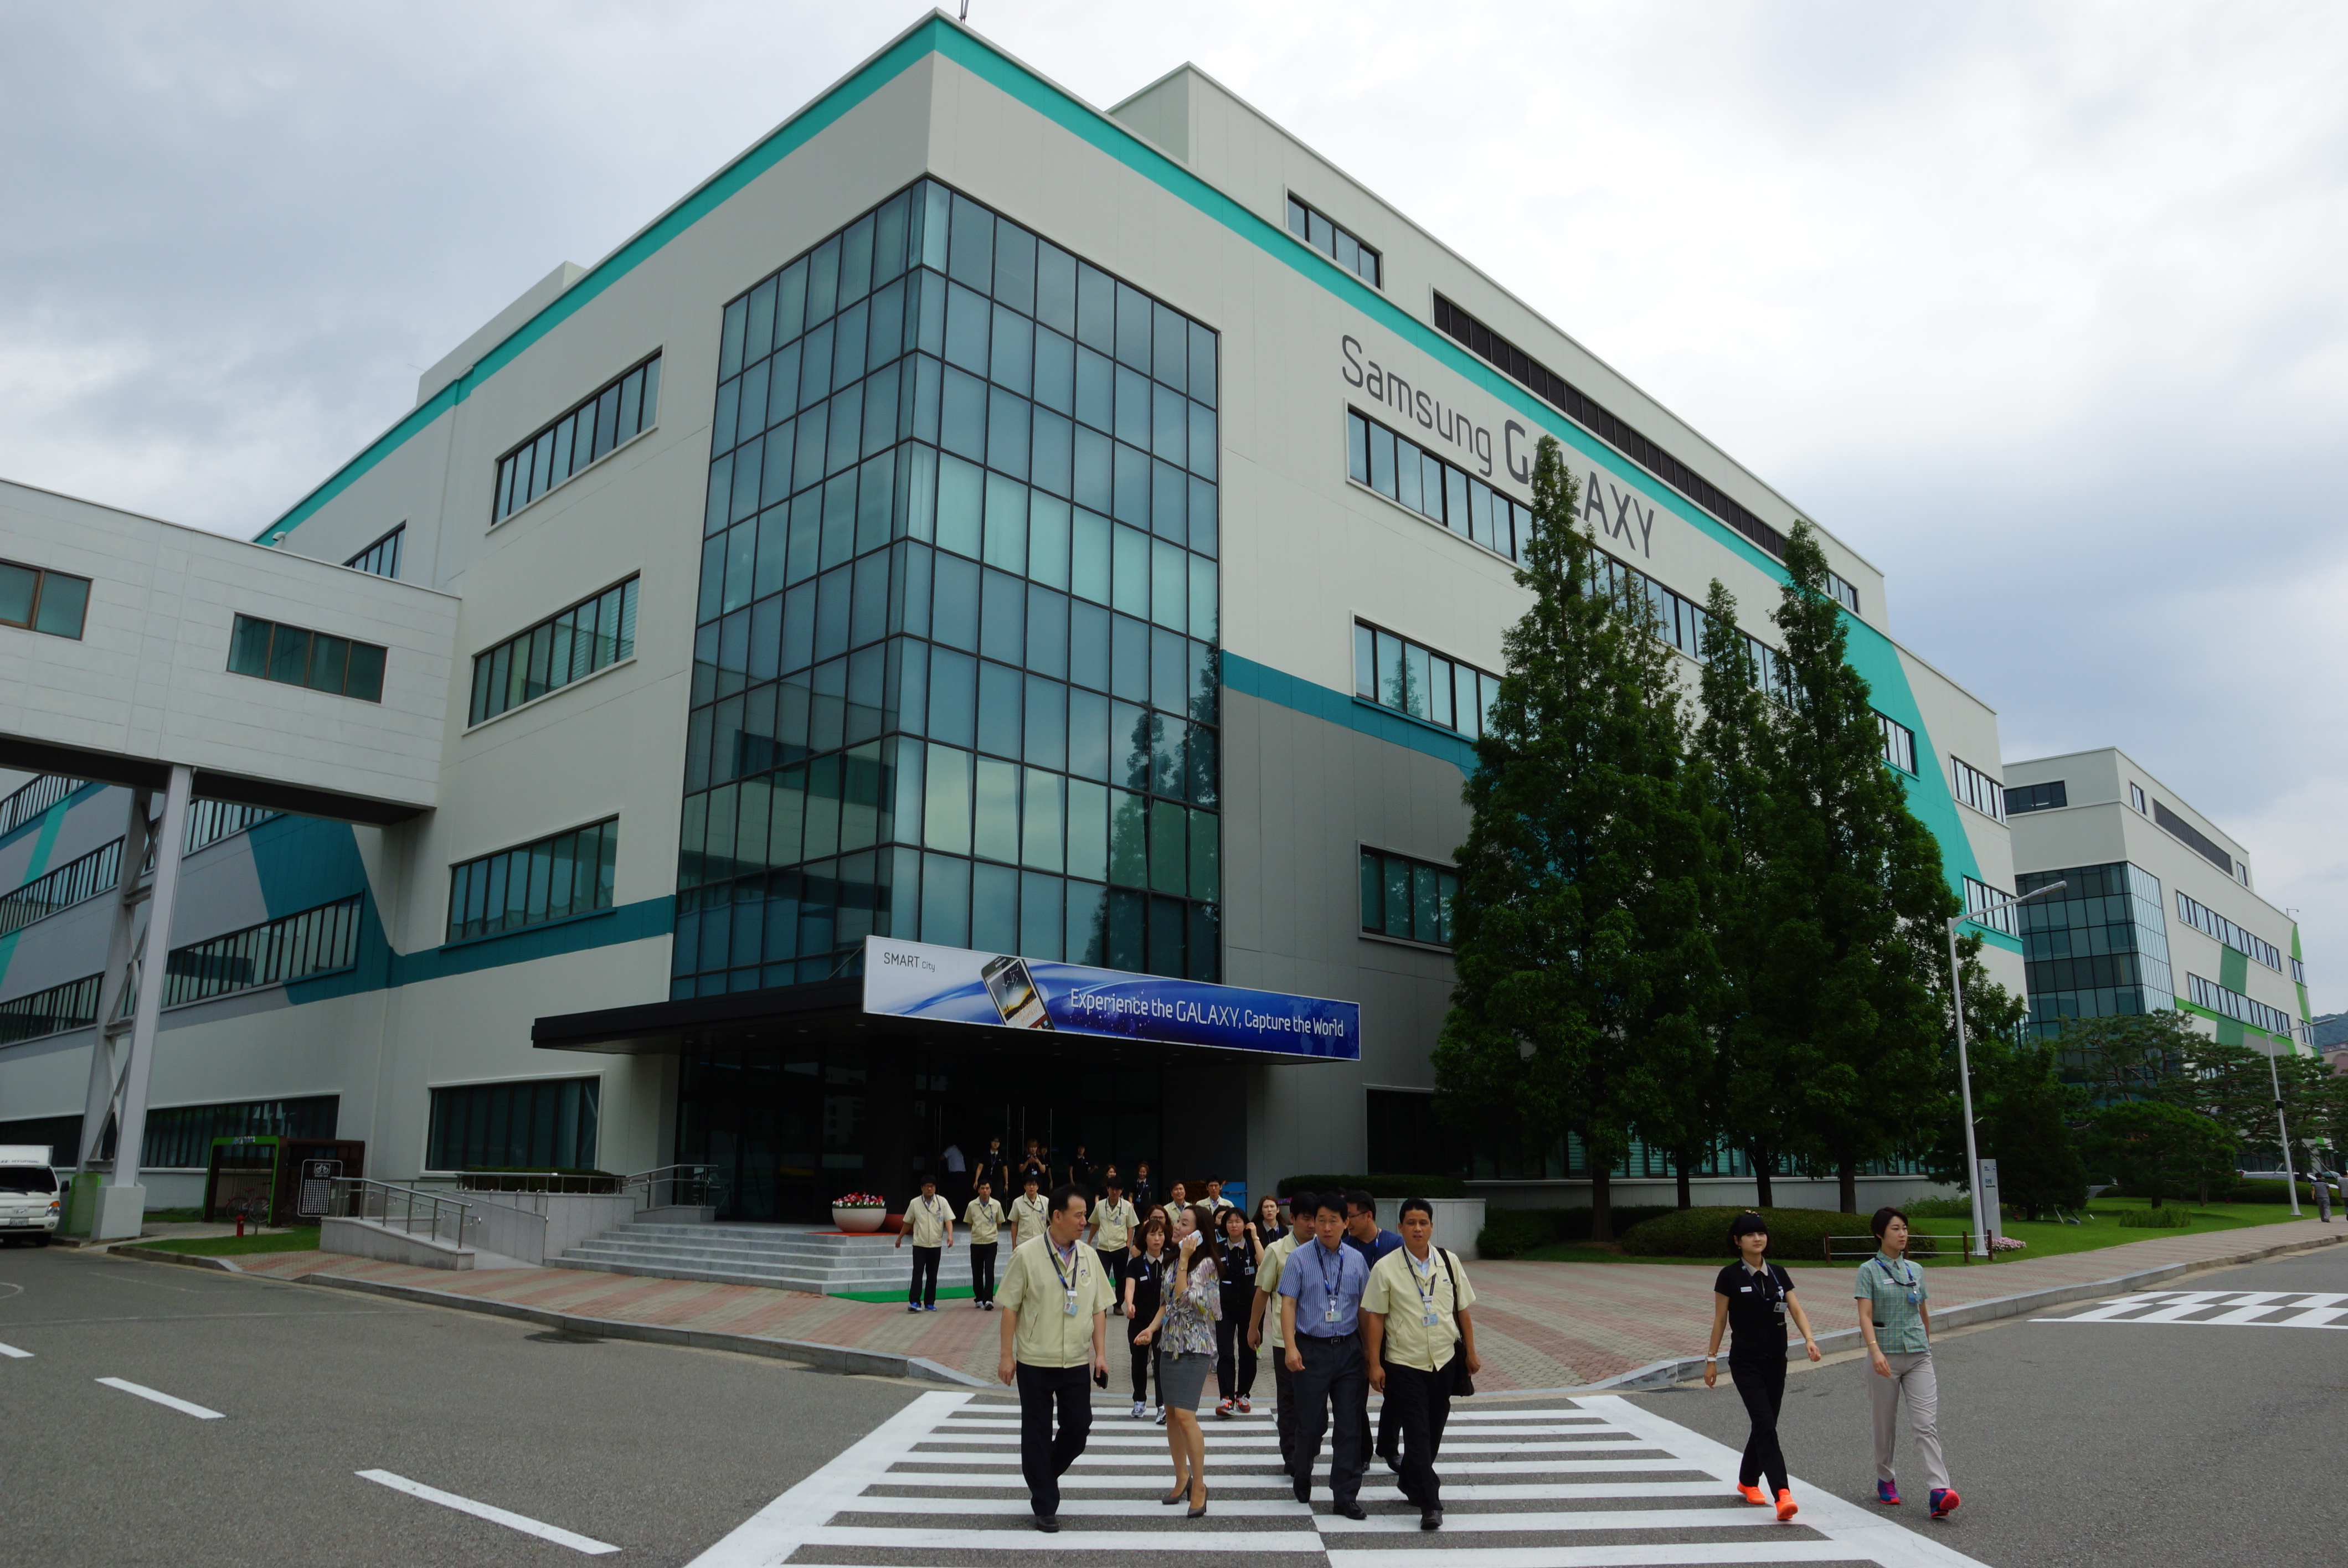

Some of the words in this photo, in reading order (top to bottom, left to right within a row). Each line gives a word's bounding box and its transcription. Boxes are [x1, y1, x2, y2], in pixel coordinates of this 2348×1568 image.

[1341, 334, 1492, 478] Samsung
[884, 952, 920, 968] SMART
[921, 961, 936, 973] City
[1070, 988, 1149, 1015] Experience
[1151, 997, 1173, 1019] the
[1176, 1000, 1242, 1029] GALAXY,
[1244, 1009, 1291, 1034] Capture
[1293, 1015, 1311, 1034] the
[1313, 1017, 1344, 1037] World
